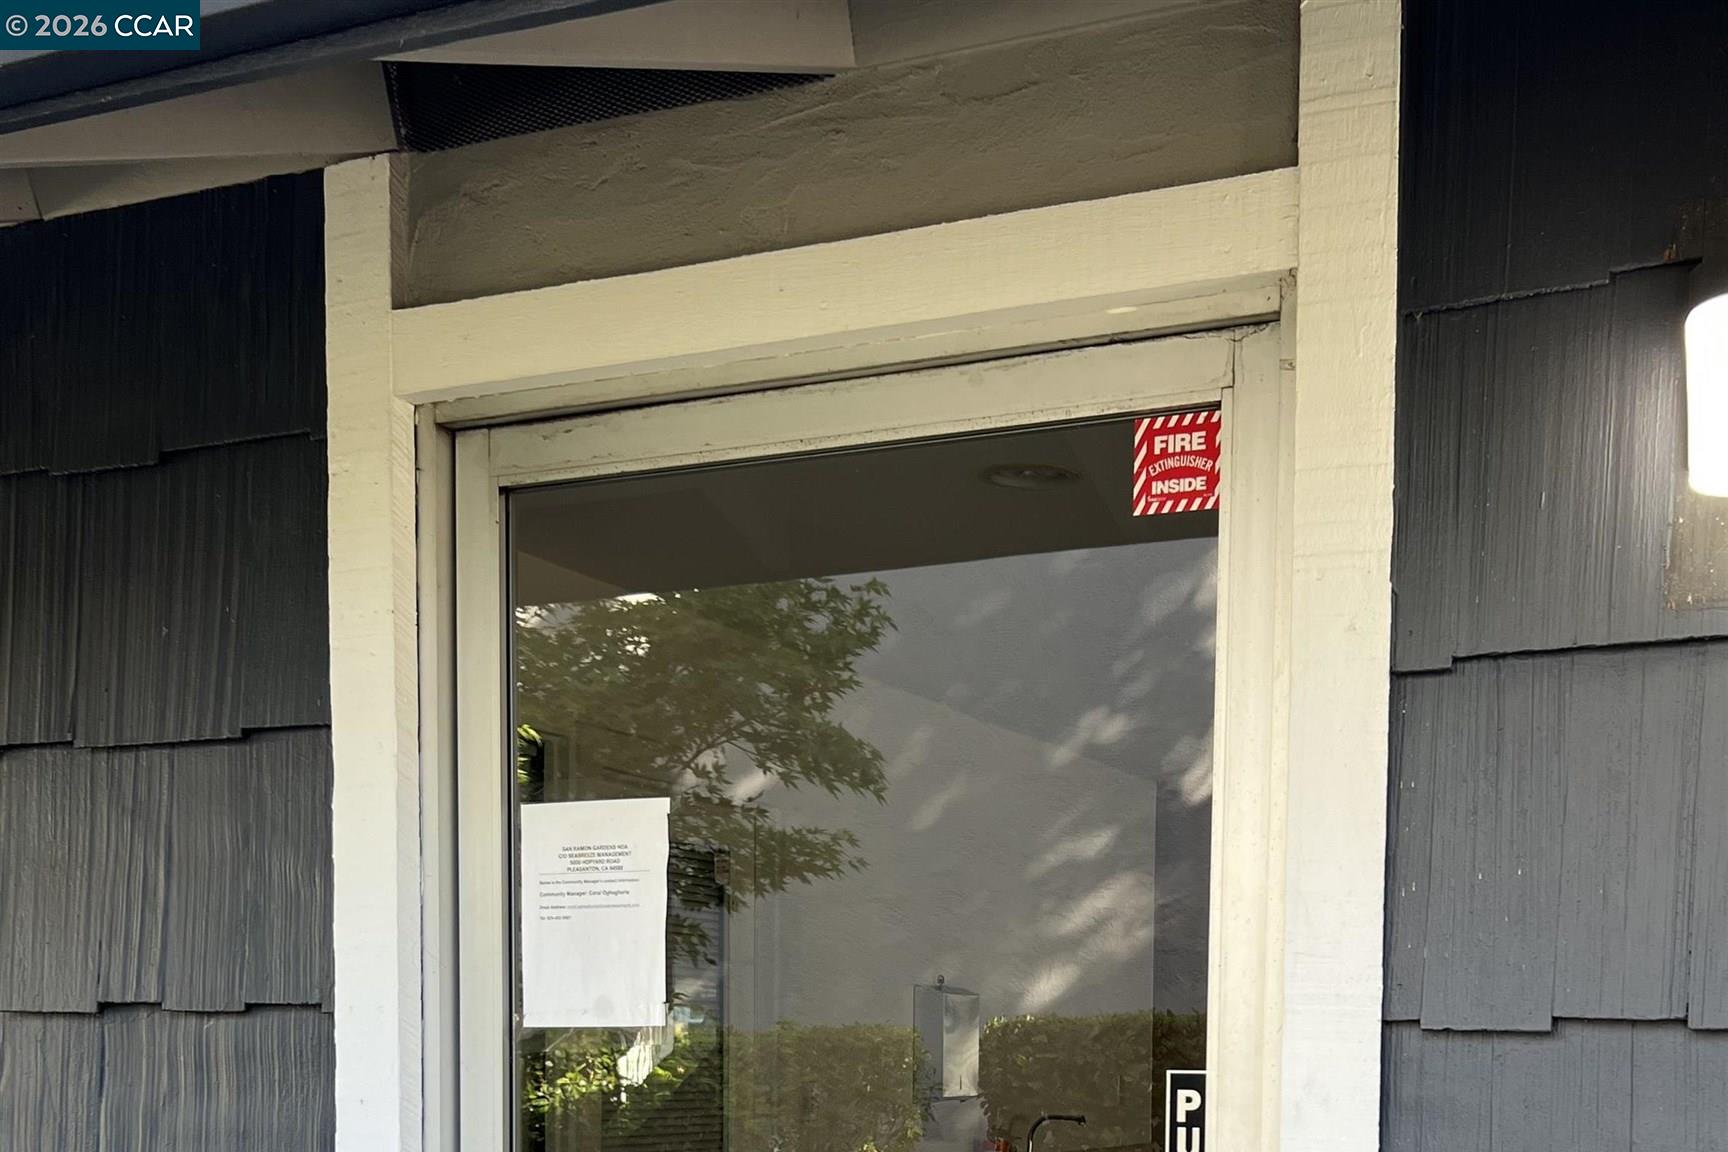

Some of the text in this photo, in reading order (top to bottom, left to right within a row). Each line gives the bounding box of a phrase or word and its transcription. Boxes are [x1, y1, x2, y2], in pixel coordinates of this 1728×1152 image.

[1154, 431, 1207, 455] FIRE
[1148, 454, 1214, 477] EXTINGUISHER
[1151, 476, 1207, 495] INSIDE
